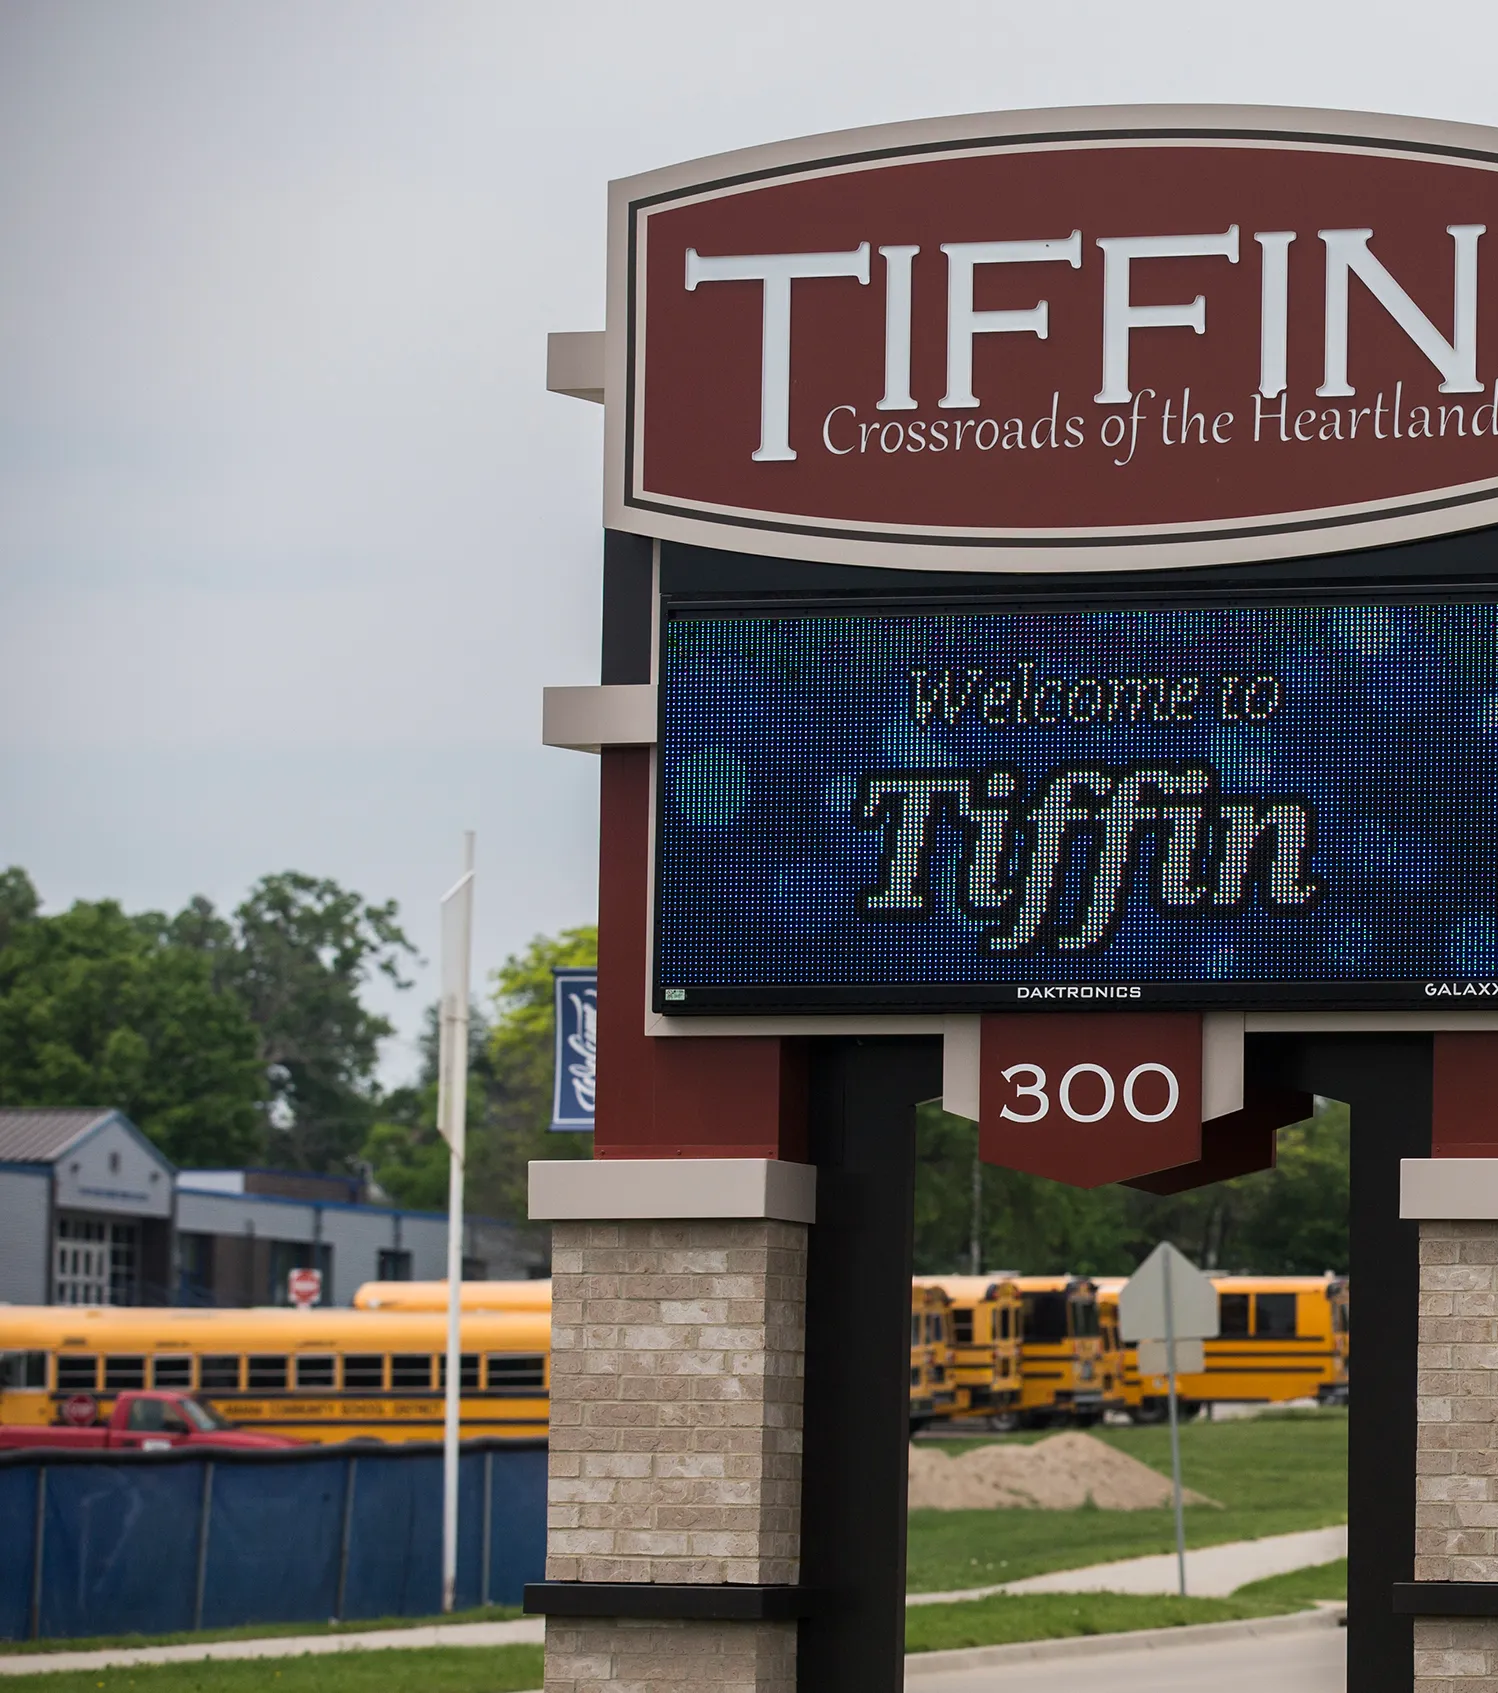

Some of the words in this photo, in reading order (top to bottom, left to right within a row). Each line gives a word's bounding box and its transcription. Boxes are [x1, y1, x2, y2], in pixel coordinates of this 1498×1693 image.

[685, 224, 1486, 461] TIFFIN
[822, 391, 1085, 455] Crossroads
[1100, 388, 1156, 466] of
[1161, 387, 1234, 446] the
[911, 662, 1199, 724] Welcome
[1221, 676, 1281, 721] to
[863, 768, 1317, 950] Tiffin
[1017, 986, 1141, 999] DAKTRONICS
[1000, 1063, 1180, 1123] 300
